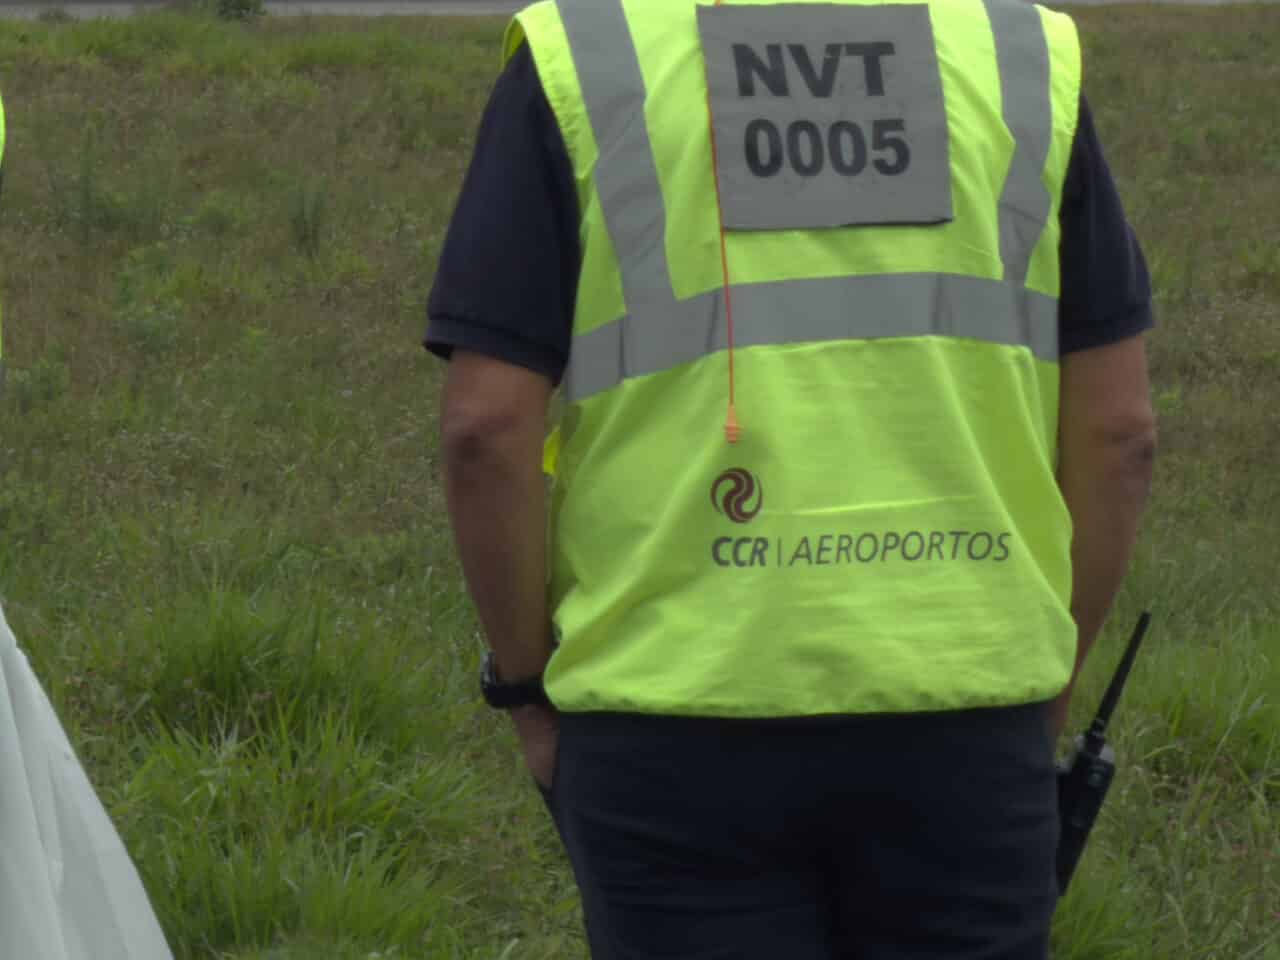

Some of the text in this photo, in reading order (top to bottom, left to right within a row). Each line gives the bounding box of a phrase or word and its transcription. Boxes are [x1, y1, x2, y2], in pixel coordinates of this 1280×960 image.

[732, 41, 896, 99] NVT
[744, 118, 910, 177] 0005
[712, 531, 1011, 567] CCR AEROPORTOS
